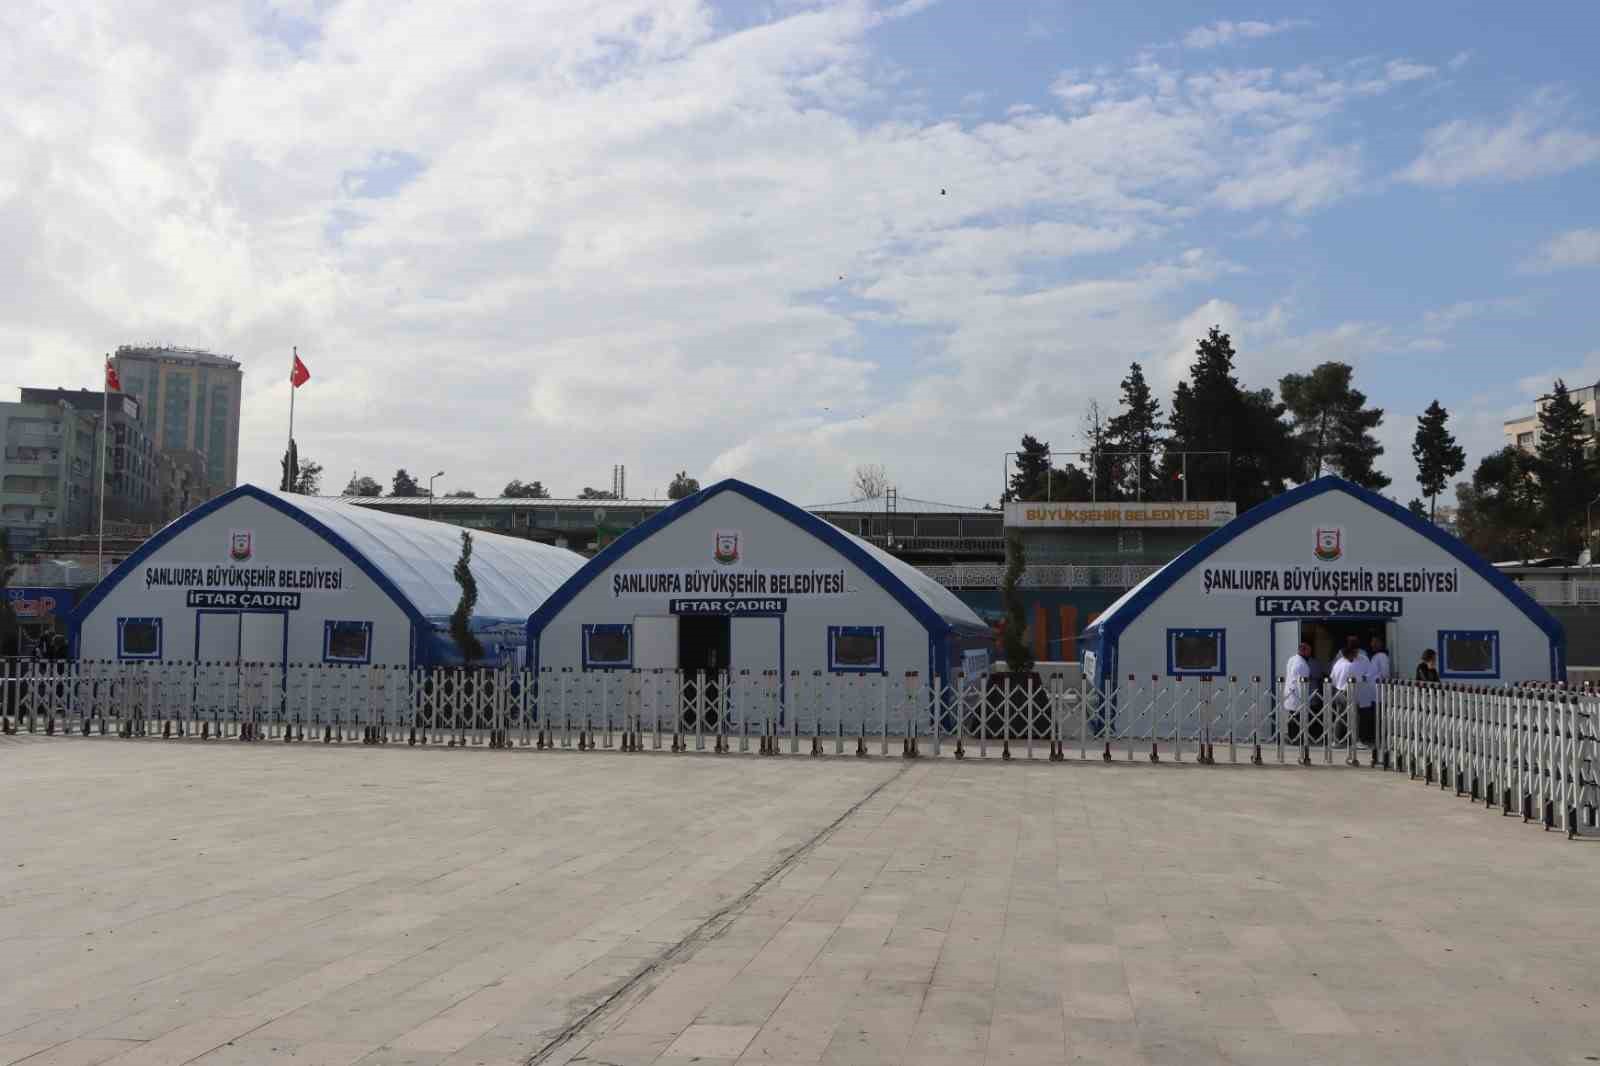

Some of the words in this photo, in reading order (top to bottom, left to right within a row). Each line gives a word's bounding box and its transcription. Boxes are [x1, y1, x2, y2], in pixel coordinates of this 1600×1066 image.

[1027, 507, 1121, 524] BÜYÜKŞEHİR
[1124, 506, 1210, 521] BELEDİYESİ
[146, 567, 204, 589] ŞANLIURFA
[207, 565, 276, 591] BÜYÜKŞEHİR
[279, 566, 343, 590] BELEDİYESİ
[614, 572, 681, 597] ŞANLIURFA
[684, 569, 766, 597] BÜYÜKŞEHİR
[770, 570, 845, 594] BELEDİYESİ
[1204, 568, 1280, 594] ŞANLIURFA
[1284, 566, 1373, 596] BÜYÜKŞEHİR
[1378, 567, 1458, 593] BELEDİYESİ
[189, 591, 237, 606] İFTAR
[240, 593, 298, 608] ÇADIRI
[674, 600, 721, 612] İFTAR
[724, 600, 781, 614] ÇADIRI
[1259, 596, 1320, 612] İFTAR
[1324, 598, 1399, 615] ÇADIRI
